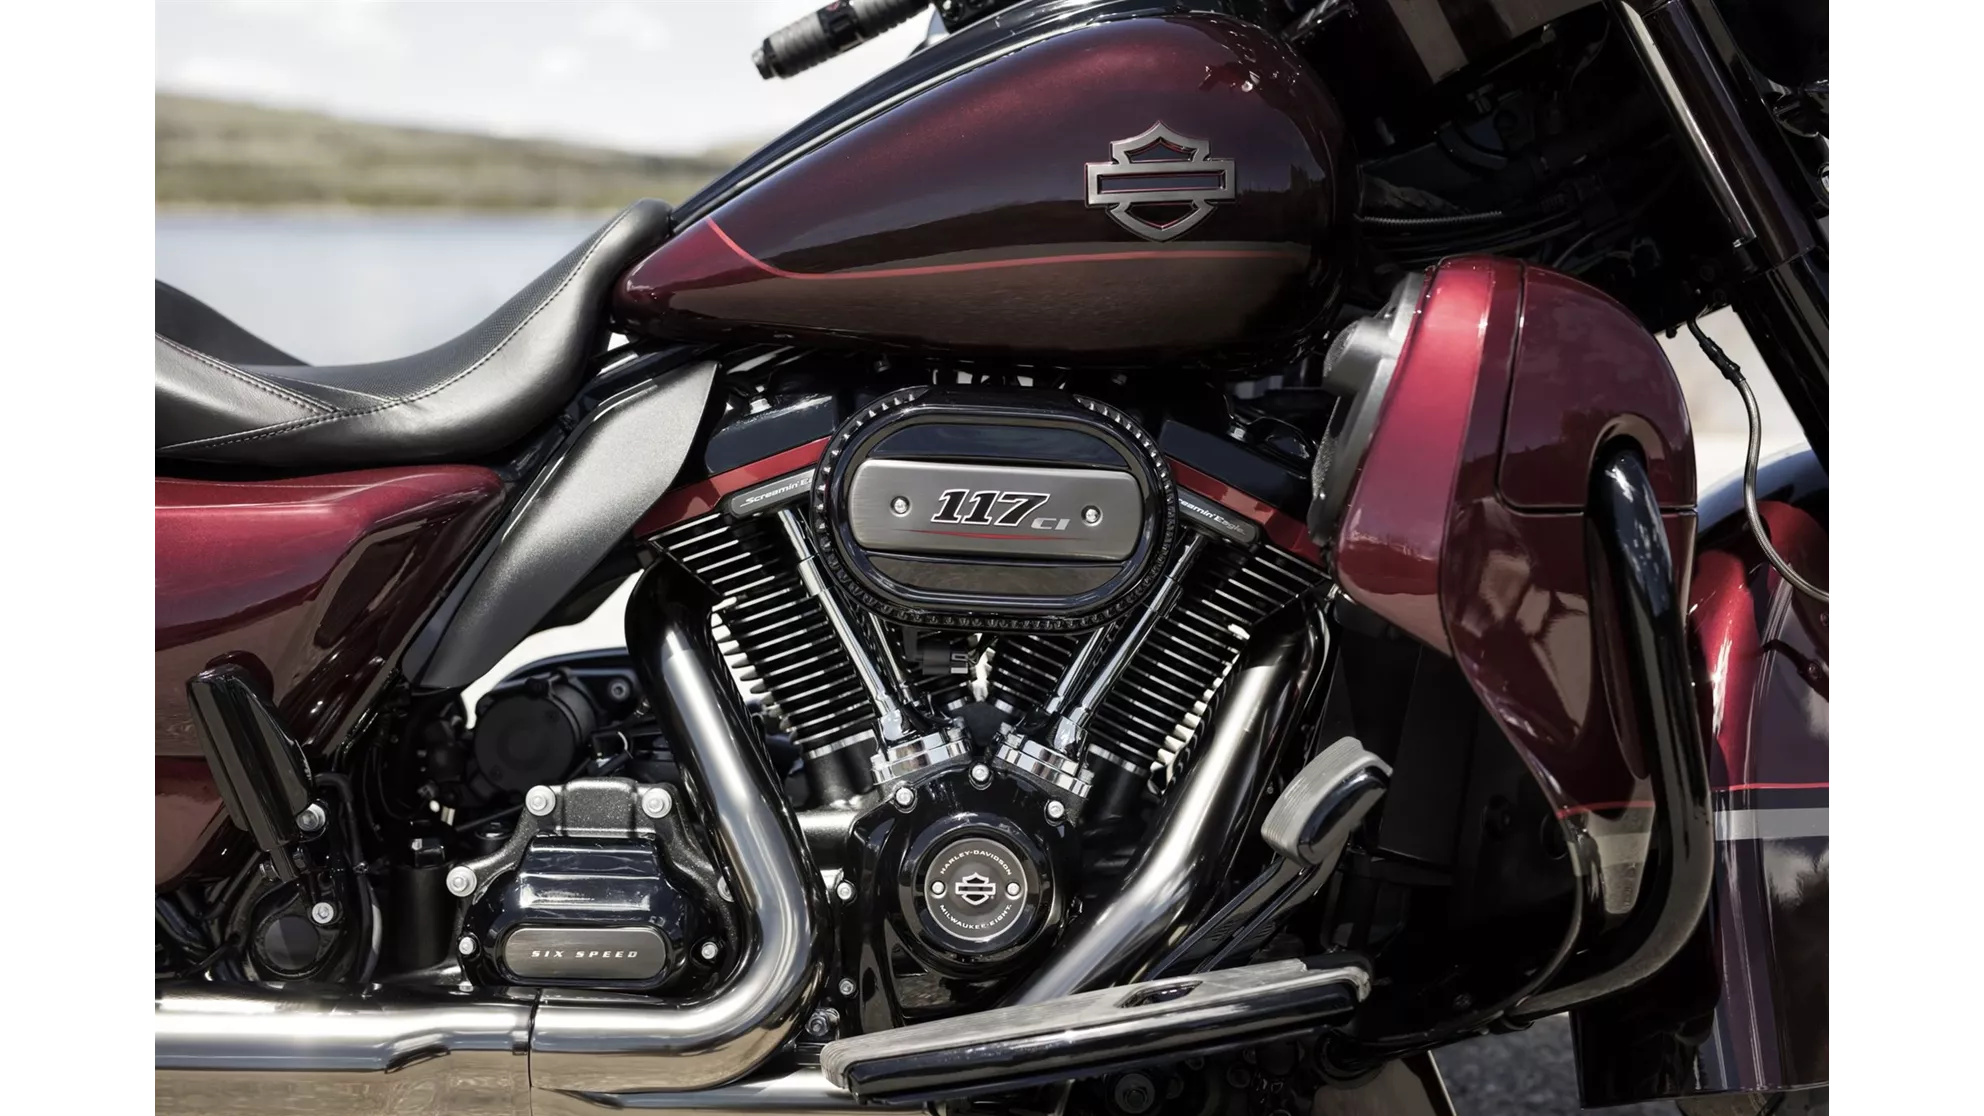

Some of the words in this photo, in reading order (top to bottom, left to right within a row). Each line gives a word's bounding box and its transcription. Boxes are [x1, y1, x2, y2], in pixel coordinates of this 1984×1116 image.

[931, 489, 1051, 527] 117
[1031, 518, 1070, 531] CI
[940, 849, 1012, 876] HARLEY-DAVIDSON
[531, 950, 564, 958] SIX
[575, 950, 638, 958] SPEED
